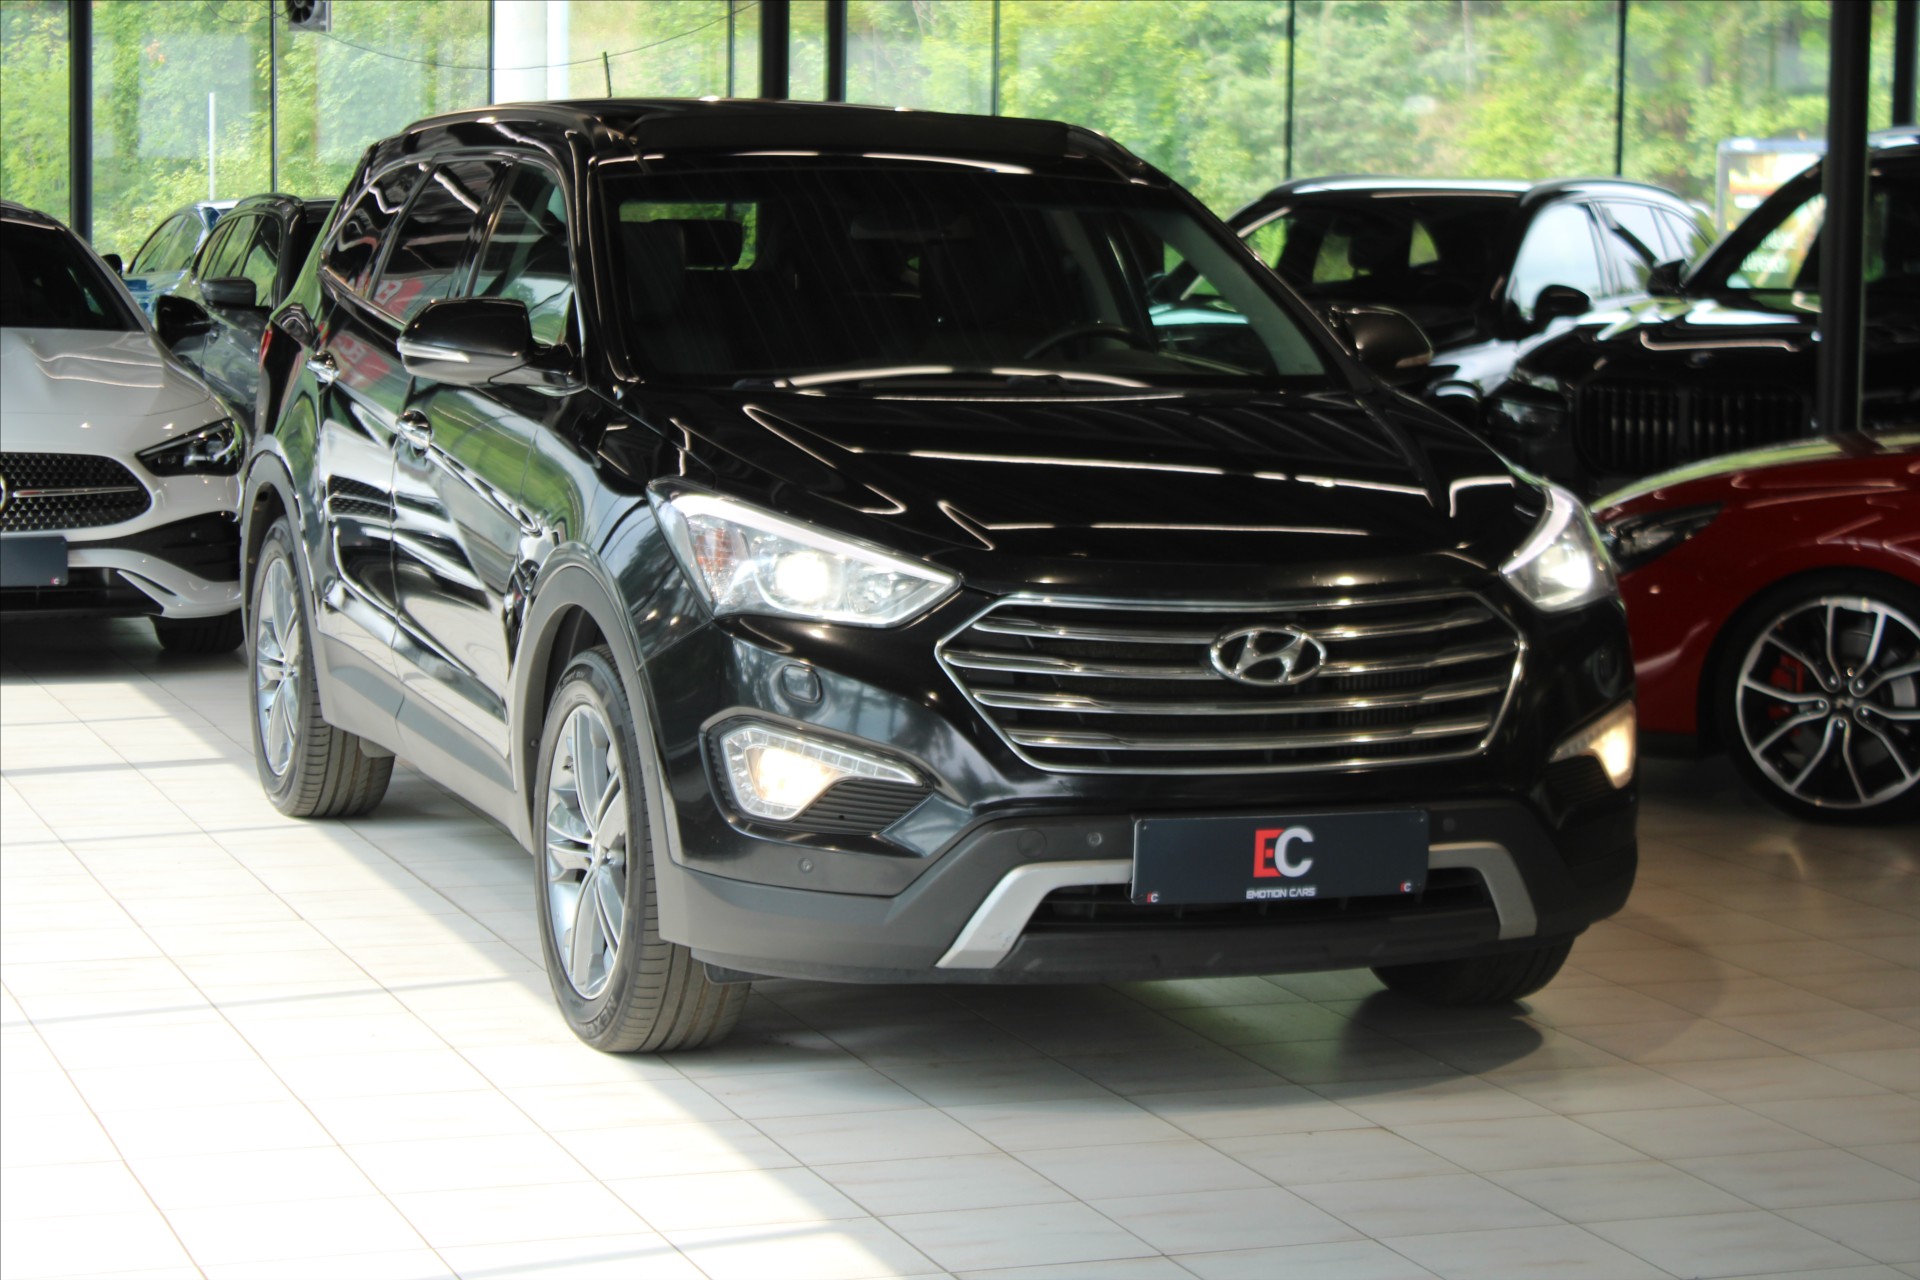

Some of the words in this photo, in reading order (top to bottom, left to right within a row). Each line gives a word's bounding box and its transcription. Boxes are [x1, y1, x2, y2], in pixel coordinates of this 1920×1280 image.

[1253, 825, 1314, 878] EC
[1245, 887, 1288, 900] EMOTION
[1288, 886, 1317, 898] CARS
